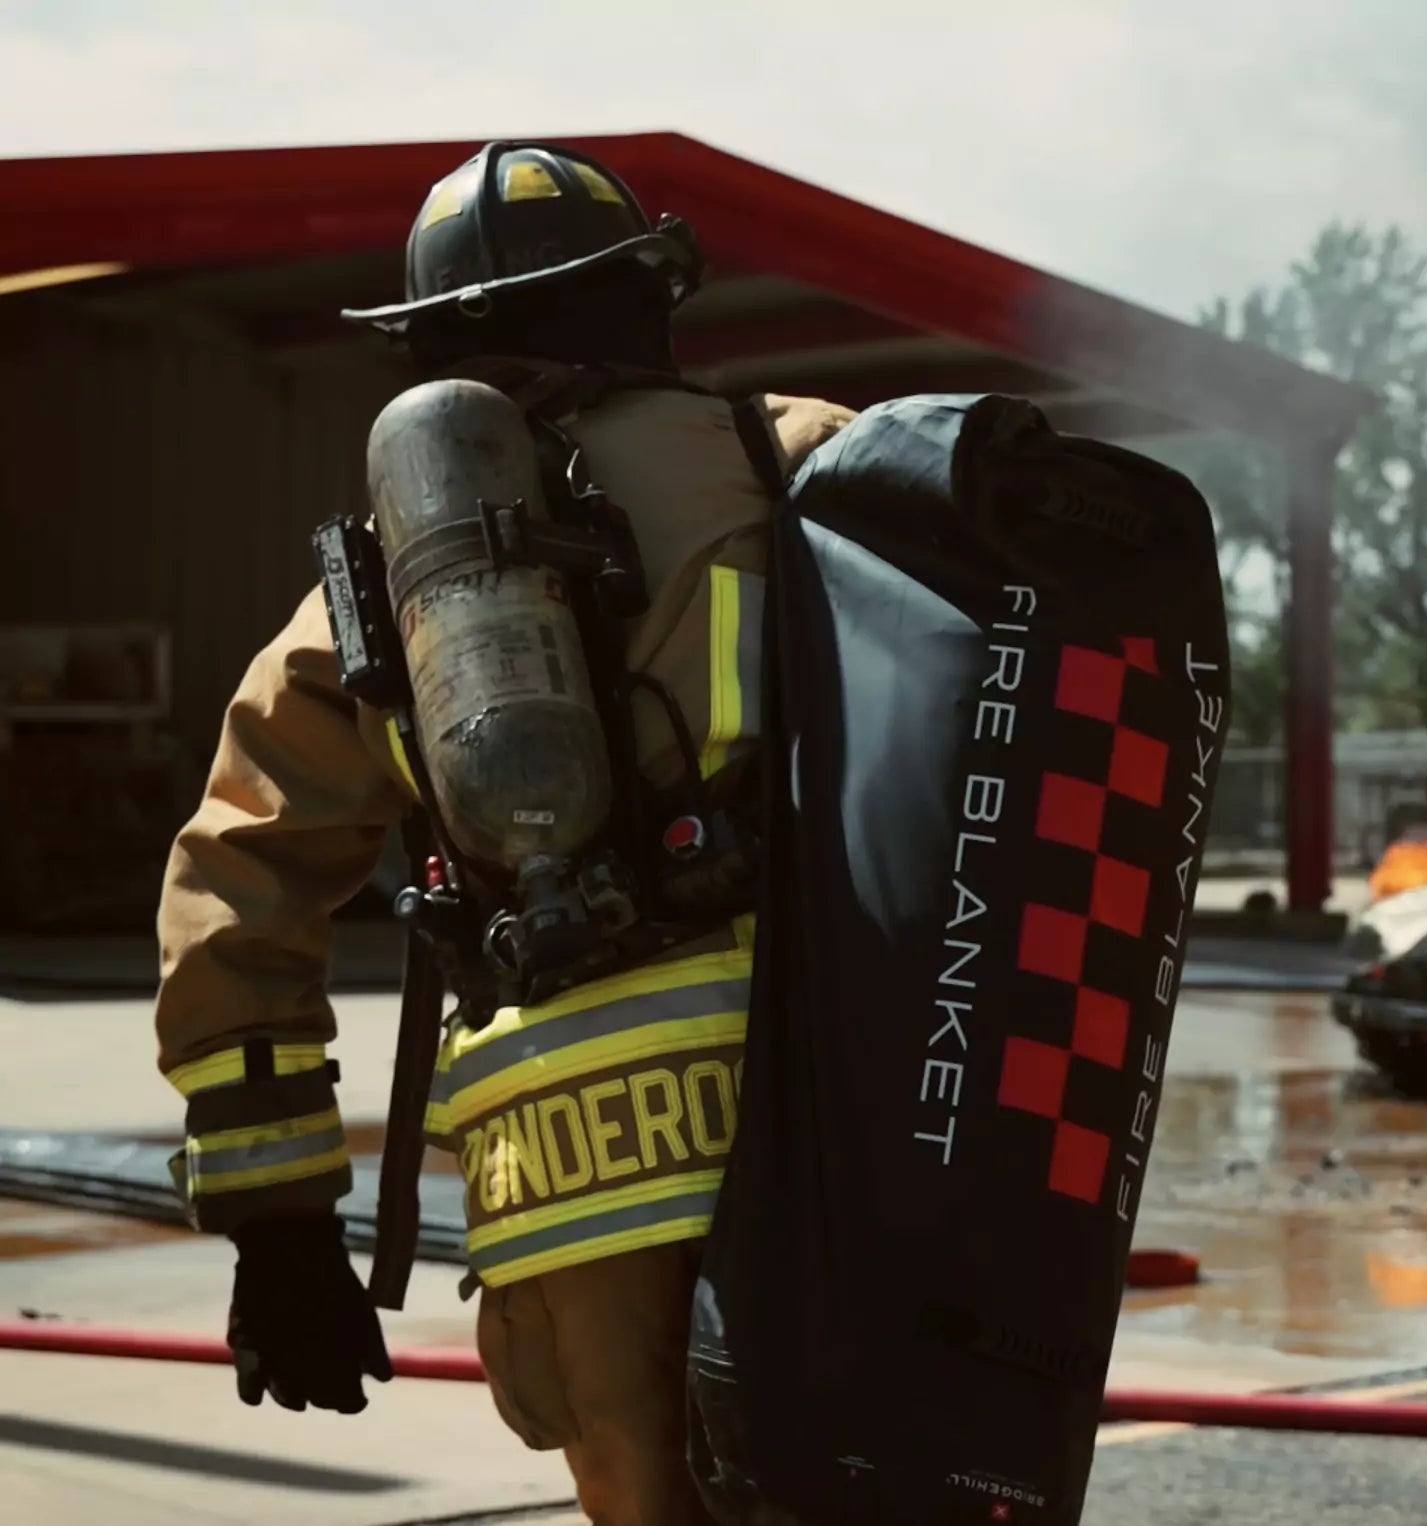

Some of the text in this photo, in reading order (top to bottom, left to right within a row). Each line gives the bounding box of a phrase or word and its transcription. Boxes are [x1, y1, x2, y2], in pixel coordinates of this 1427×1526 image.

[461, 1057, 745, 1212] PONDERO
[914, 585, 1037, 1166] FIRE BLANKET
[1116, 642, 1223, 1221] FIRE BLANKET
